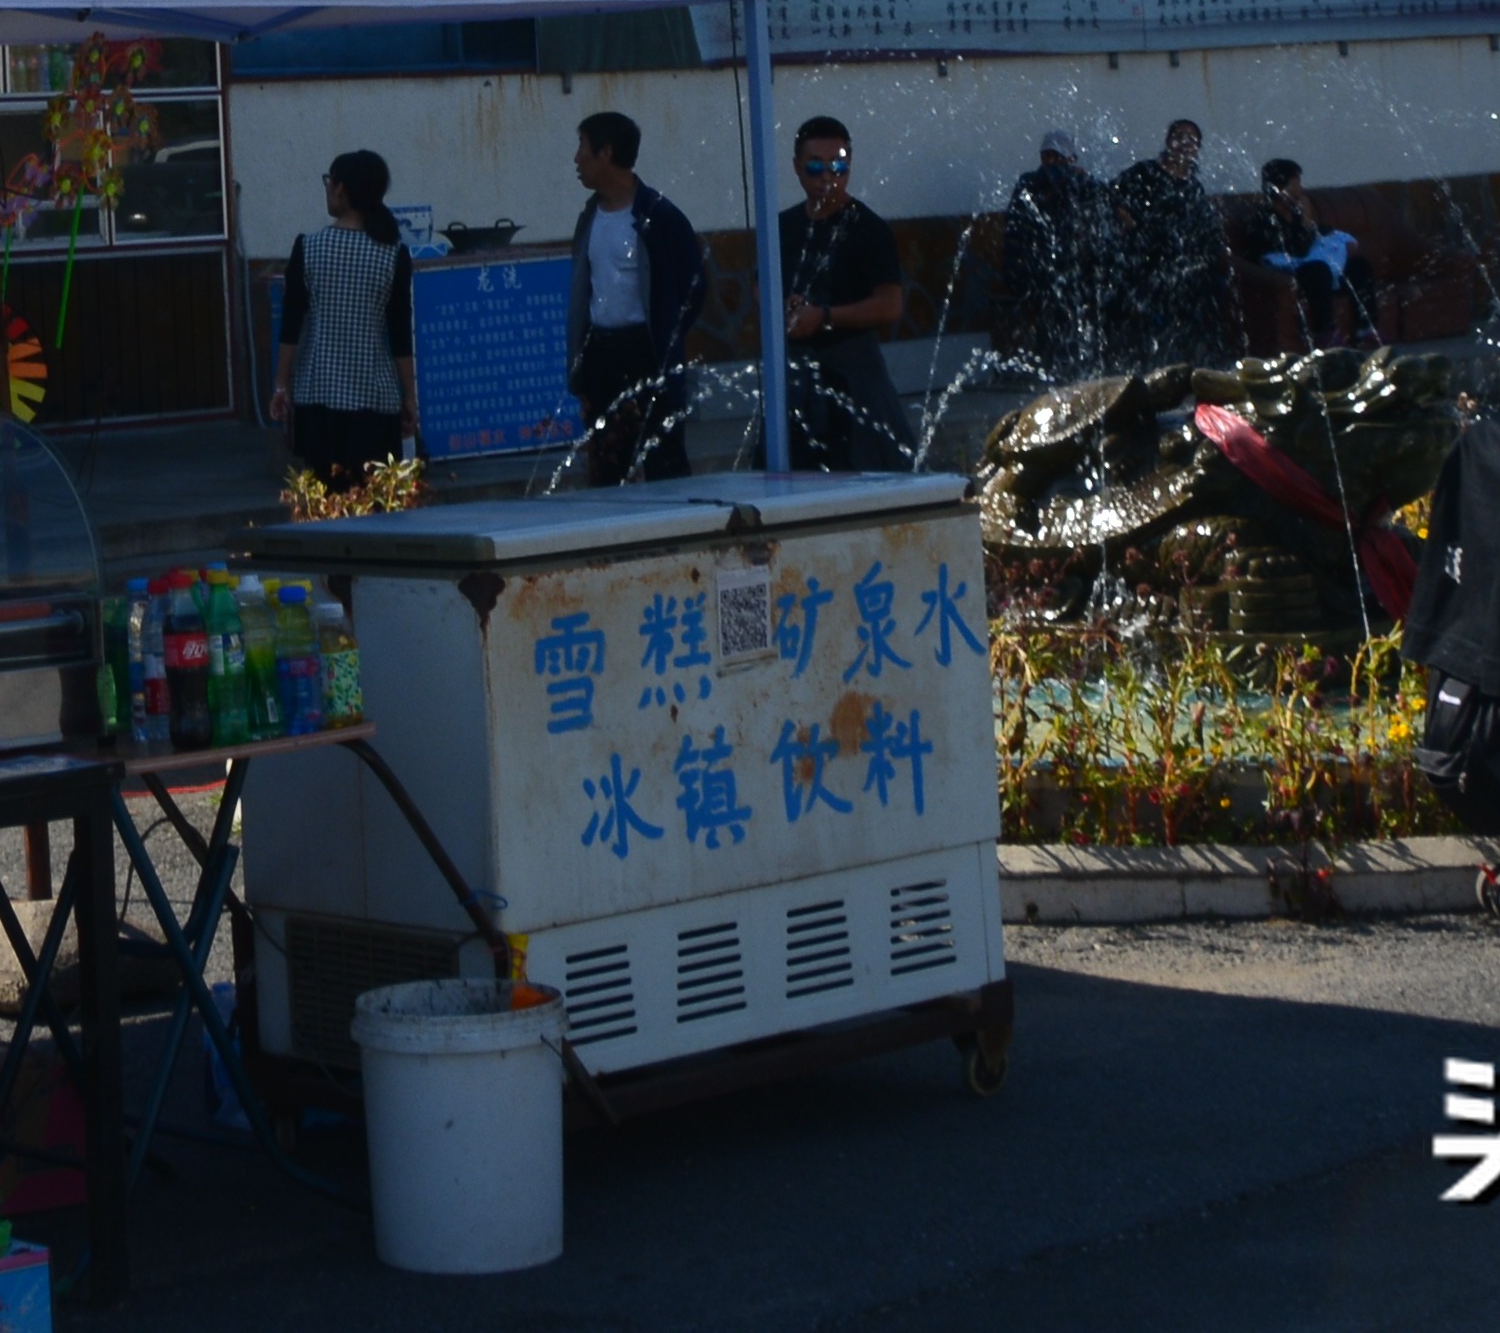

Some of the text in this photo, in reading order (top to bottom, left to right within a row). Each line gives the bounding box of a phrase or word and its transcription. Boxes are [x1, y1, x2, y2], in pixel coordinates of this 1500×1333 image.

[533, 561, 987, 736] 雪糕 矿泉水
[581, 708, 933, 860] 冰镇饮料
